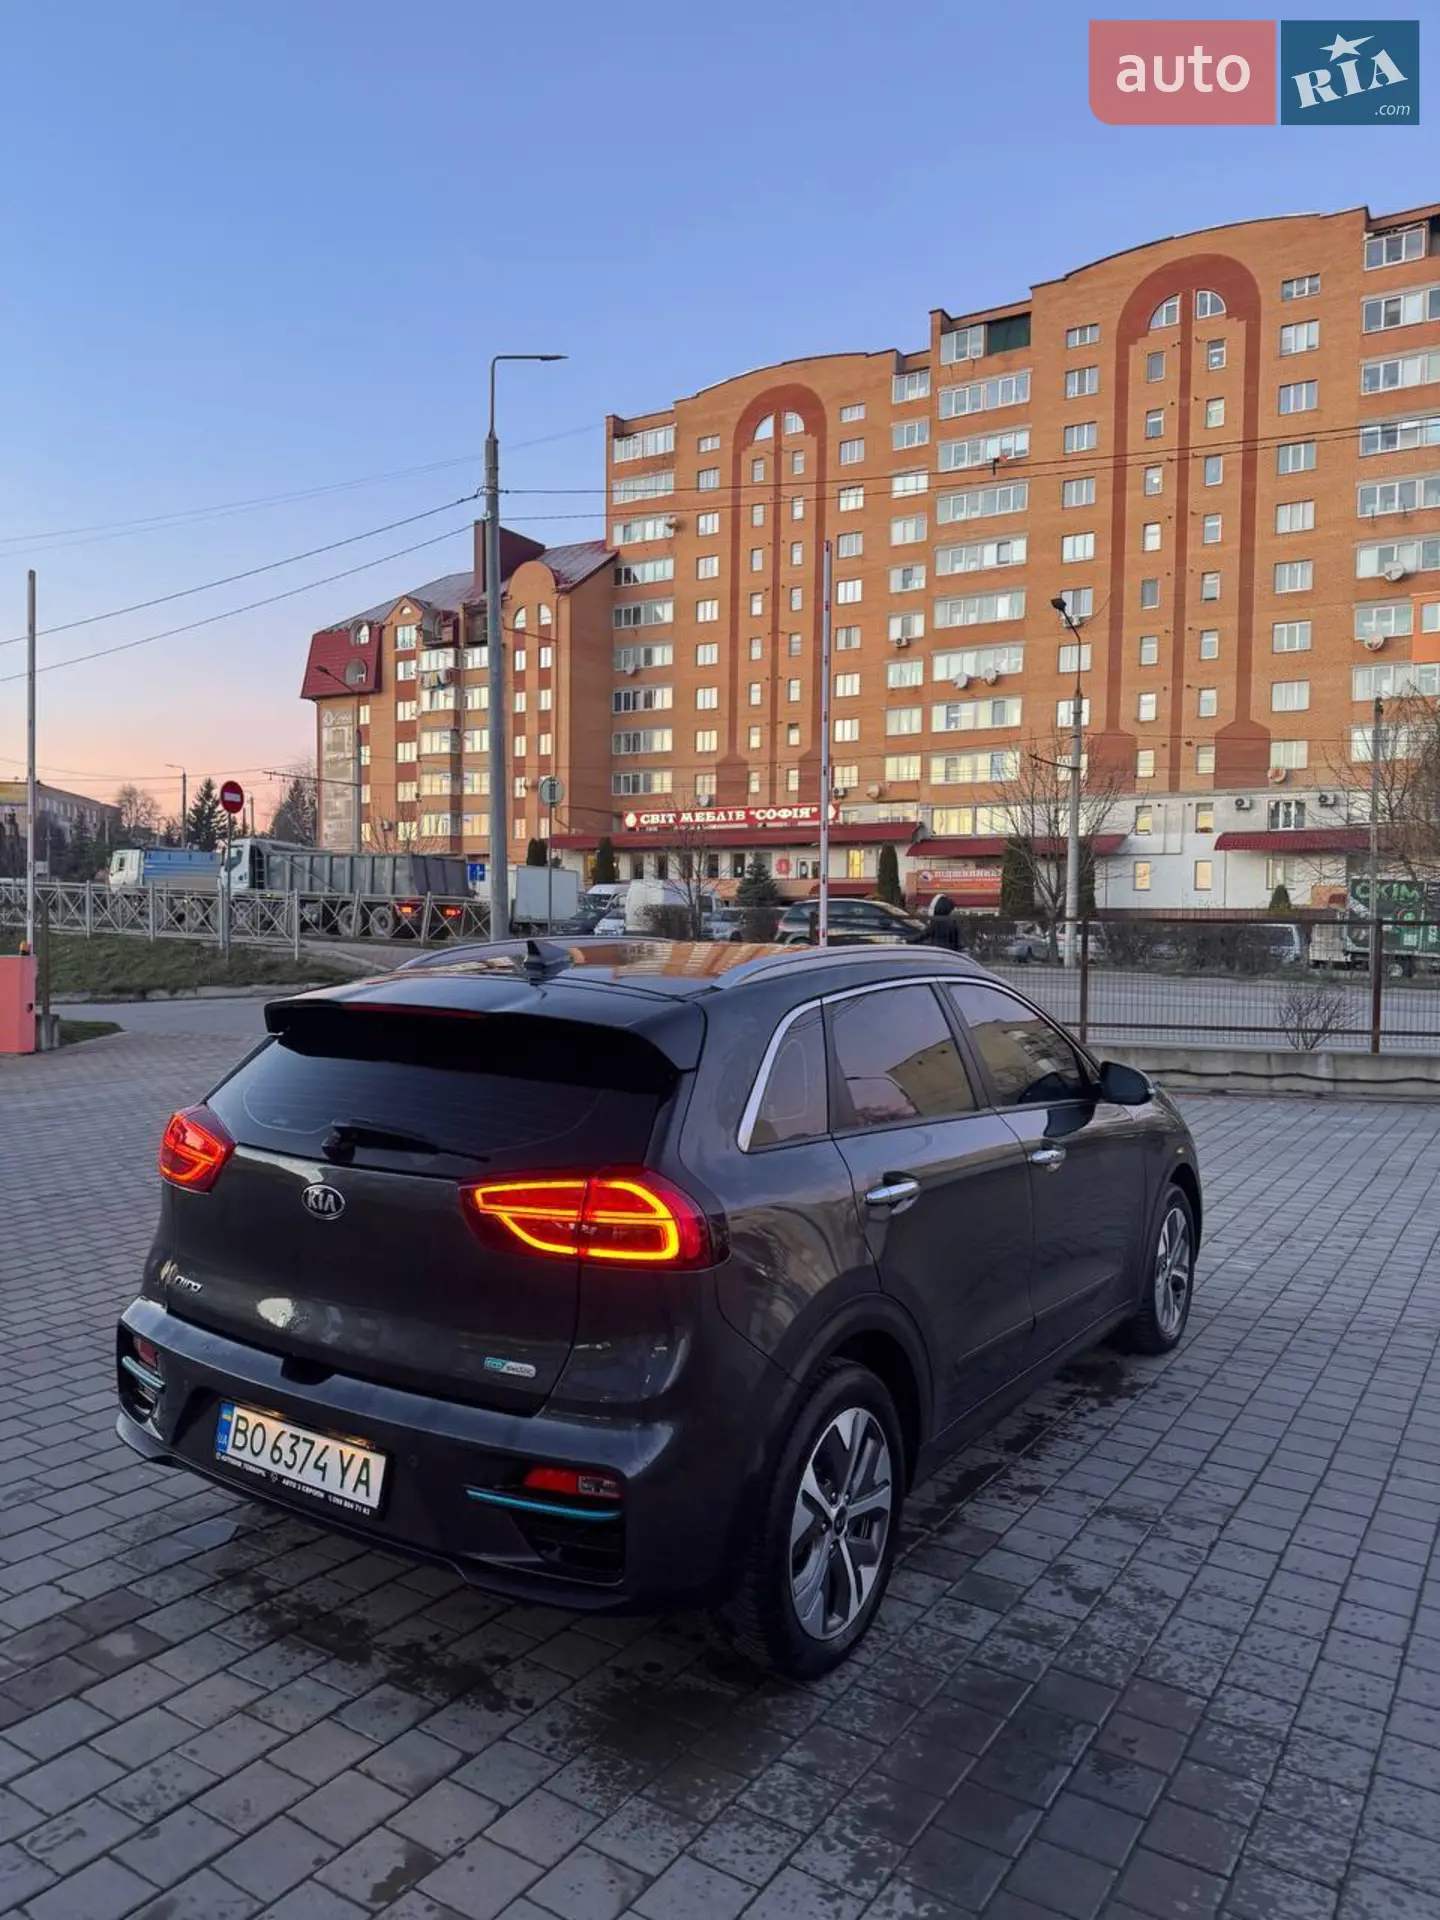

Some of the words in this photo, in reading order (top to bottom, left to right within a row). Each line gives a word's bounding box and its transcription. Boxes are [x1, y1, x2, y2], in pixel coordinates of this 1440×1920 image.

[640, 813, 677, 825] СВІТ
[680, 807, 746, 823] МЕБЛІВ
[308, 1189, 336, 1212] KIA
[231, 1416, 267, 1457] BO
[270, 1430, 330, 1482] 6374
[339, 1450, 371, 1497] YA
